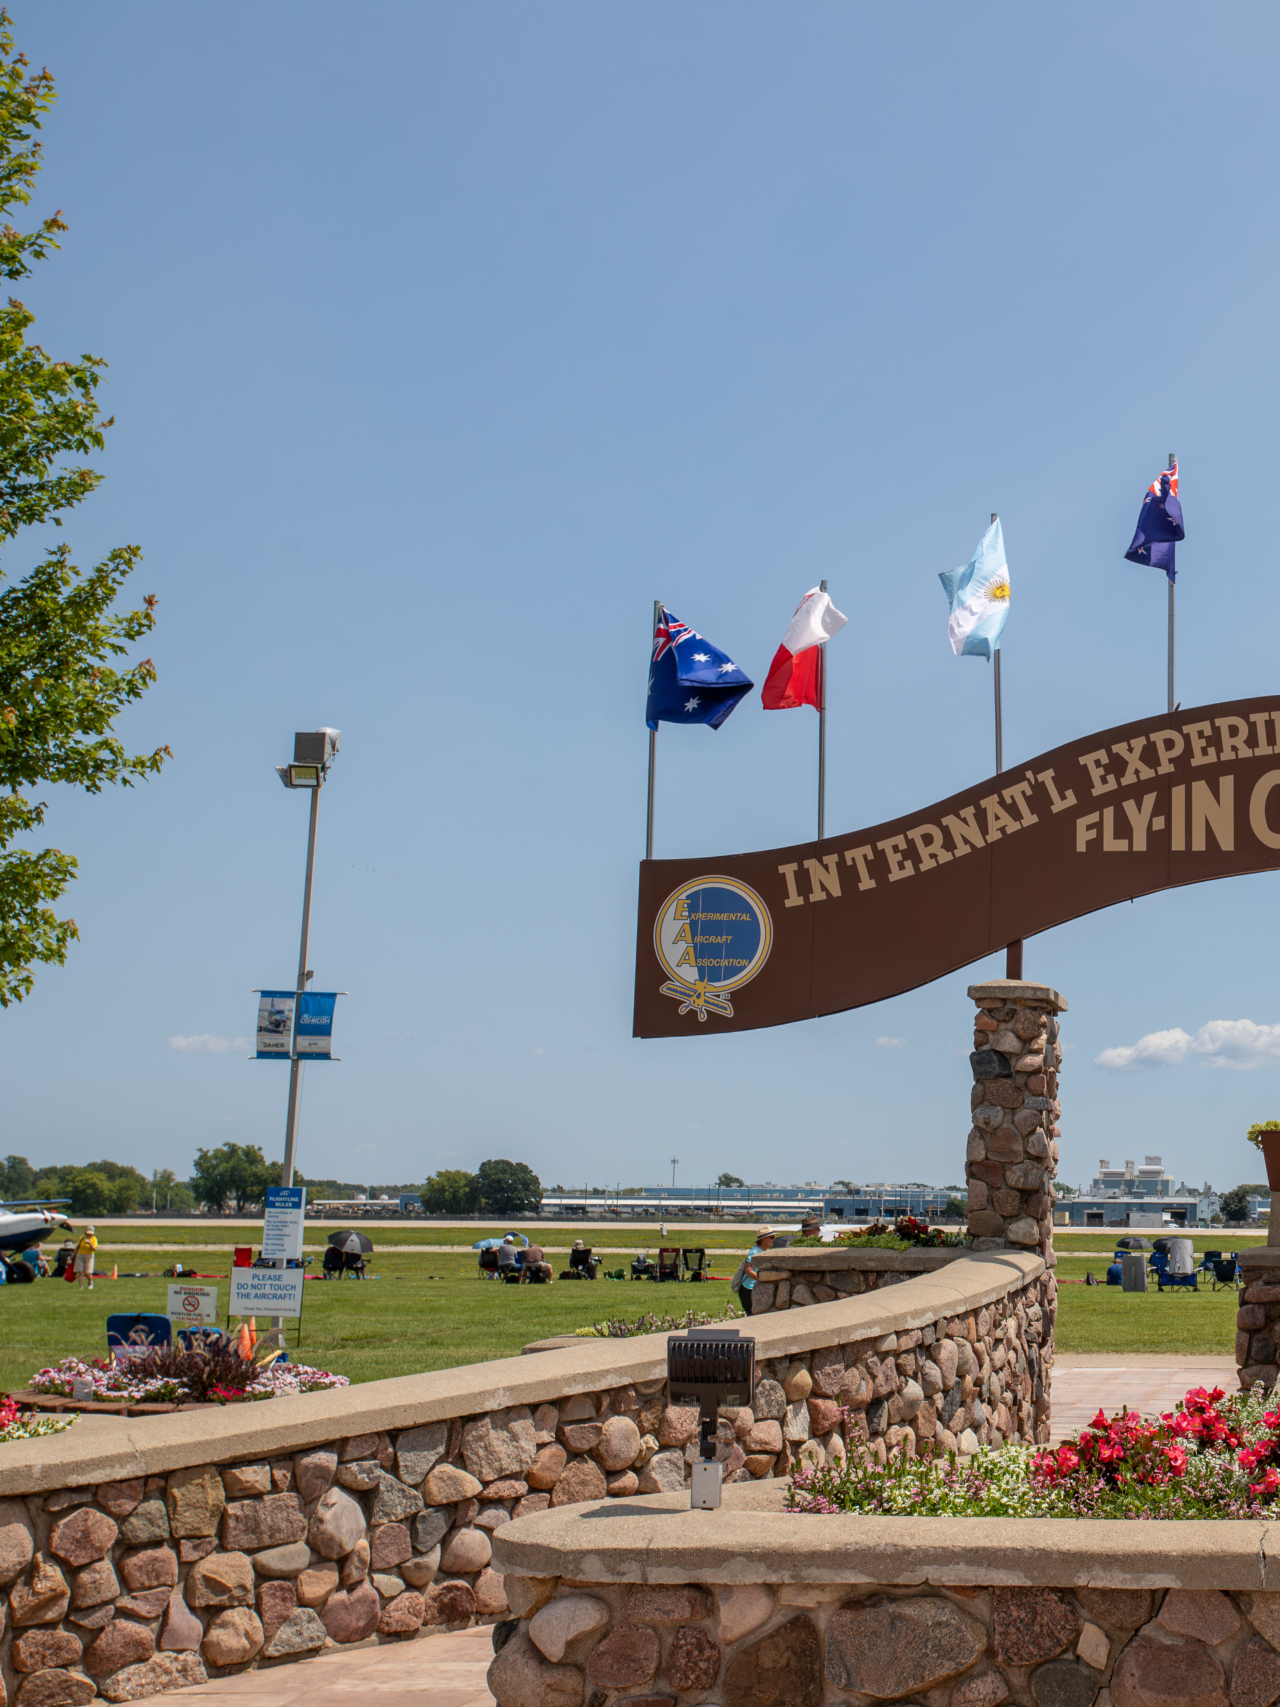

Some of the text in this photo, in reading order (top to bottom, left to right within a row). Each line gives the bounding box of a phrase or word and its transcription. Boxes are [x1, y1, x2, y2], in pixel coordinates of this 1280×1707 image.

[1076, 774, 1235, 852] FLY-IN
[778, 768, 1078, 908] INTERNAT'L
[673, 899, 751, 921] EXPERIMENTAL
[672, 922, 733, 944] AIRCRAFT
[676, 945, 750, 967] ASSOCIATION
